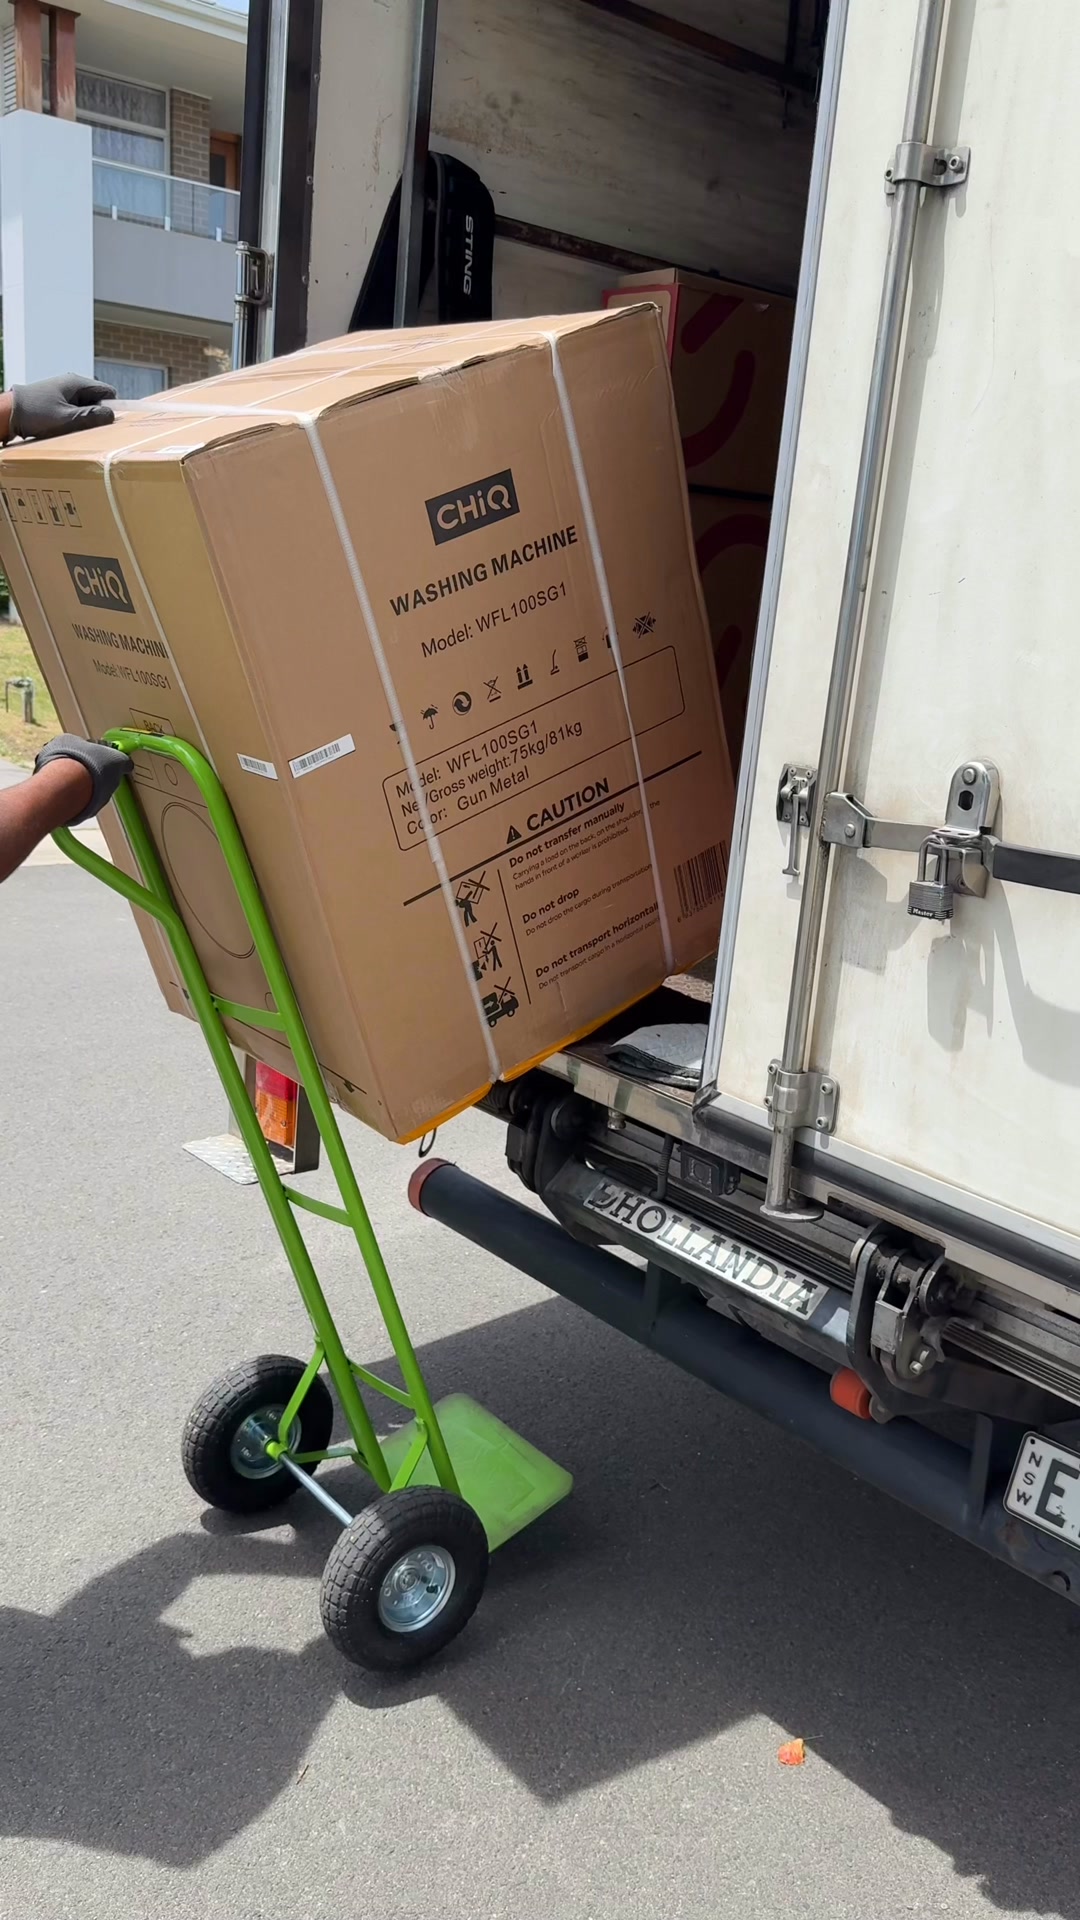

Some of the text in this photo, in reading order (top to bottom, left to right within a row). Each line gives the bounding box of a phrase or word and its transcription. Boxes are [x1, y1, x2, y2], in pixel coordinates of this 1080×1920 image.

[463, 214, 474, 295] STING
[437, 484, 512, 530] CHiQ
[73, 565, 128, 604] CHiQ
[389, 525, 578, 617] WASHING MACHINE
[72, 623, 119, 648] WASHING
[421, 581, 567, 658] Model: WFL100SG1
[445, 719, 539, 774] WFL100SG1
[400, 777, 466, 818] Ne/Gross
[406, 765, 530, 835] Coor: Gun Metal
[526, 777, 611, 832] CAUTION
[509, 801, 626, 868] Do not transfer manually
[559, 848, 569, 856] on
[568, 841, 580, 852] the
[596, 828, 606, 837] on
[605, 821, 616, 832] the
[514, 877, 535, 891] hands
[535, 872, 542, 881] in
[542, 864, 558, 877] front
[557, 858, 567, 869] of
[522, 888, 580, 924] Do not drop
[525, 926, 536, 937] Do
[536, 919, 547, 930] not
[547, 912, 563, 926] drop
[563, 905, 574, 916] the
[574, 897, 592, 911] cargo
[535, 965, 550, 978] Do
[551, 954, 569, 969] not
[569, 929, 612, 959] transport
[612, 901, 659, 934] horizontall
[538, 979, 549, 990] Do
[548, 973, 560, 984] not
[588, 1183, 818, 1316] DHOLLANDIA
[1034, 1458, 1080, 1529] E
